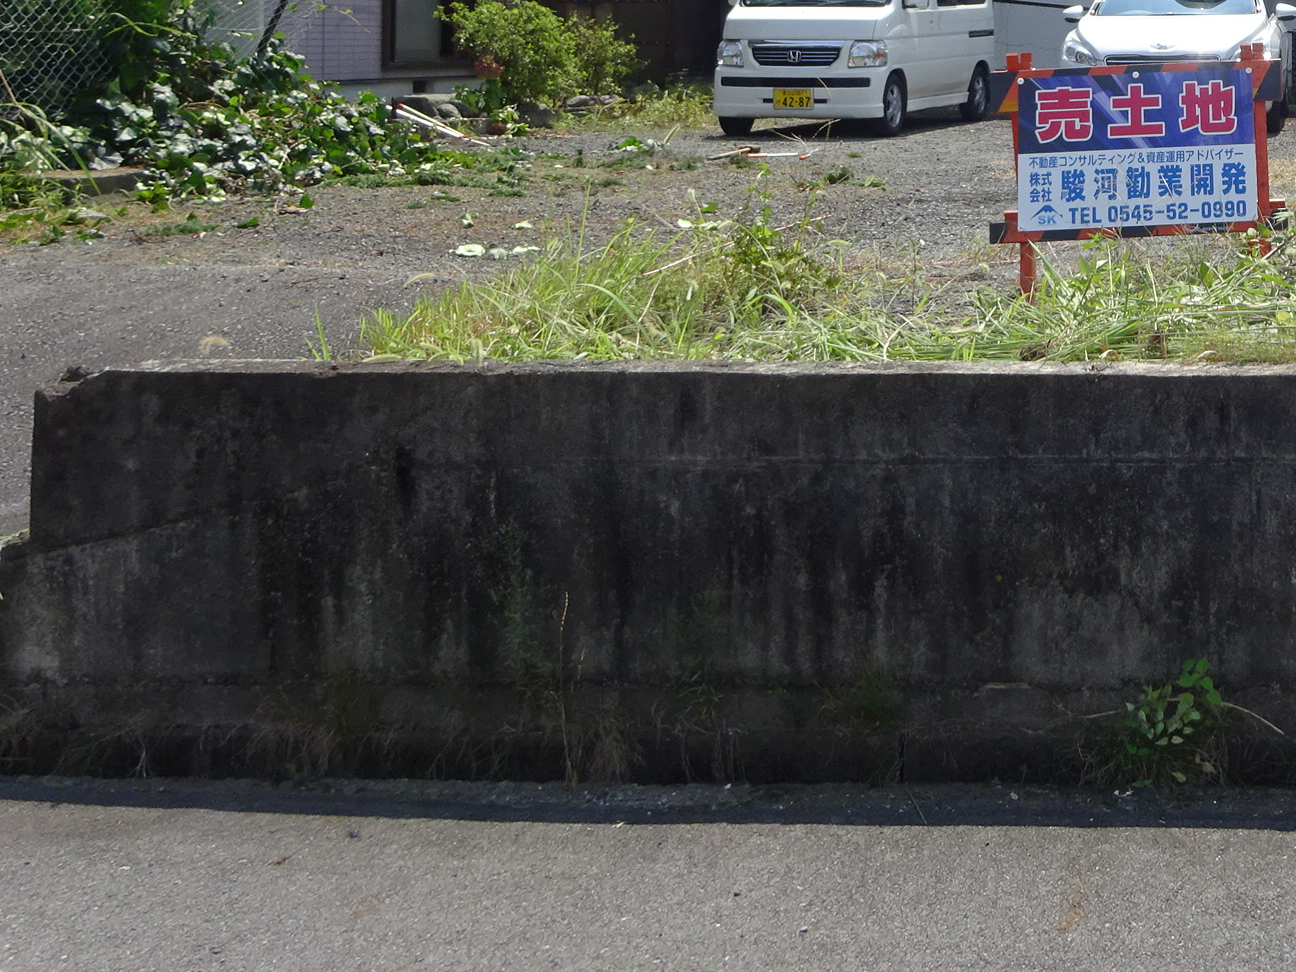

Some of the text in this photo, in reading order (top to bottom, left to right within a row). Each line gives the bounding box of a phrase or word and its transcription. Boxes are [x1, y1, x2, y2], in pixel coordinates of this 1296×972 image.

[782, 96, 811, 107] 42-87
[1035, 79, 1237, 144] 売土地
[1029, 171, 1052, 187] 株式
[1029, 187, 1052, 203] 会社
[1037, 215, 1057, 225] SK
[1068, 200, 1247, 225] TEL 0545-52-0990
